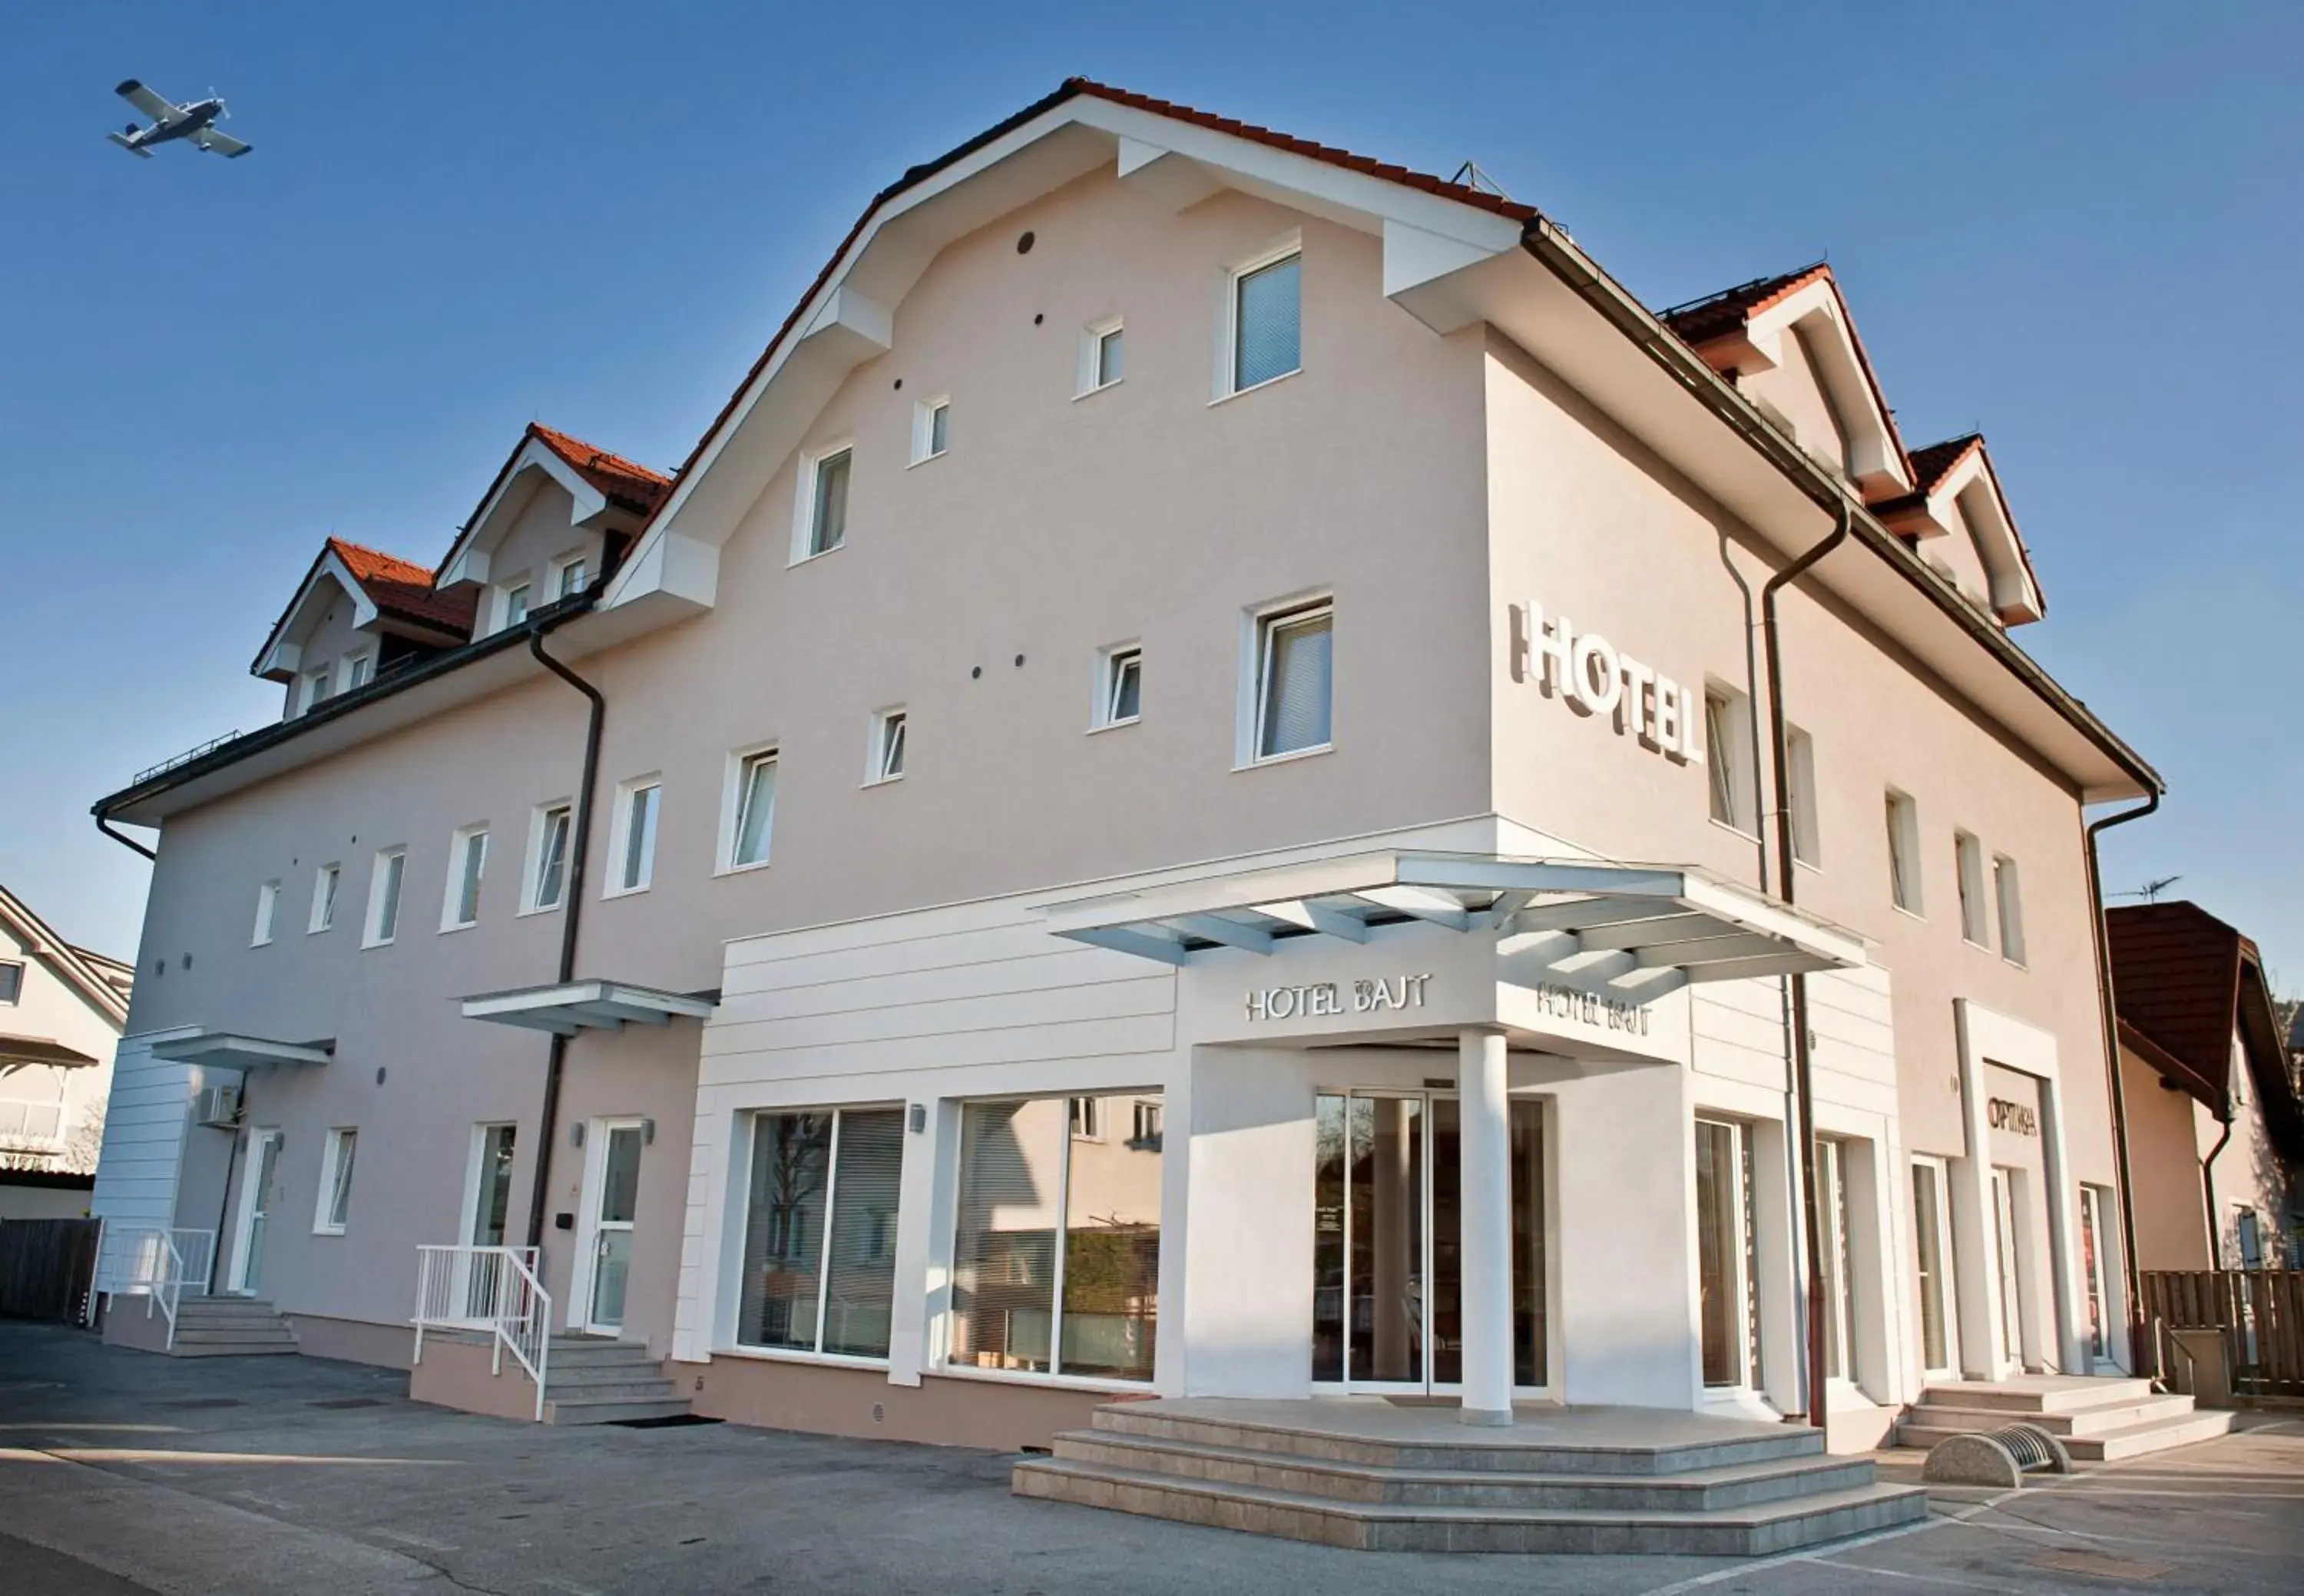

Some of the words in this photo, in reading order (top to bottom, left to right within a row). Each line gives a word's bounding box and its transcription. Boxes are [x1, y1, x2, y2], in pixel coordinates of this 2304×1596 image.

[1526, 599, 1704, 765] HOTEL
[1246, 983, 1343, 1022] HOTEL
[1353, 973, 1432, 1012] BAJT
[1538, 982, 1601, 1026] HOTEL
